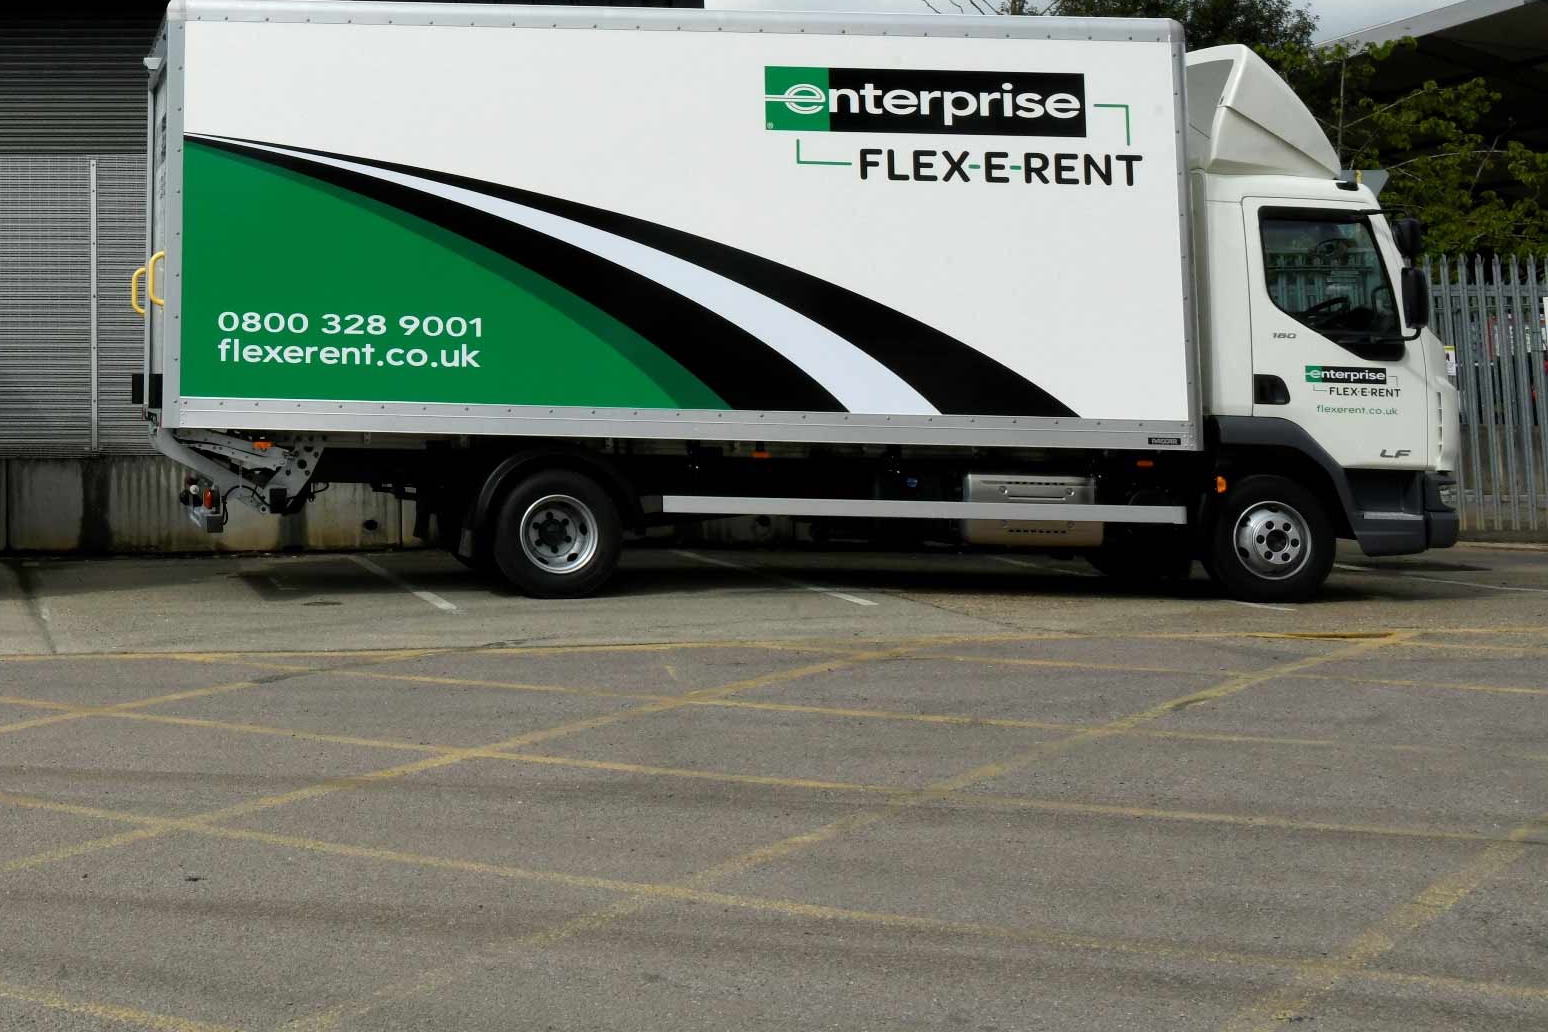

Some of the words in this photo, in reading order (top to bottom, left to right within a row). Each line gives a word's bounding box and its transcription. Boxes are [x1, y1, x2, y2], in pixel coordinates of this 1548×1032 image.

[785, 81, 1082, 127] enterprise
[858, 147, 1145, 188] FLEX-E-RENT
[217, 311, 309, 334] 0800
[321, 313, 388, 336] 328
[398, 315, 483, 338] 9001
[217, 338, 482, 368] flexerent.co.uk
[1310, 369, 1386, 381] enterprise
[1316, 405, 1398, 415] flexerent.co.uk
[1380, 449, 1412, 458] LF
